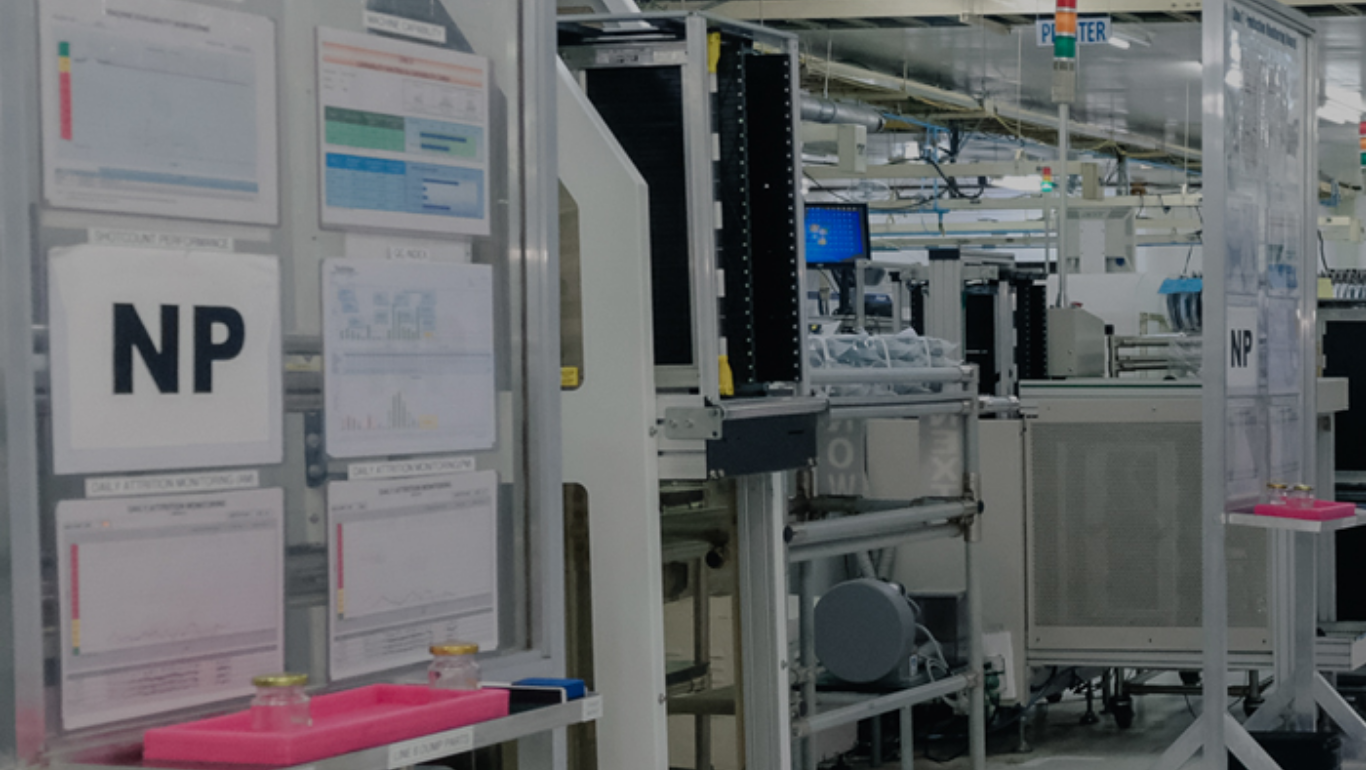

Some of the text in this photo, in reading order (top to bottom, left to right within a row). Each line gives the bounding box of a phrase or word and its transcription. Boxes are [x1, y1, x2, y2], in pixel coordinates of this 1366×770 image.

[1041, 21, 1107, 43] PTER
[113, 303, 245, 394] NP
[1231, 329, 1253, 368] NP
